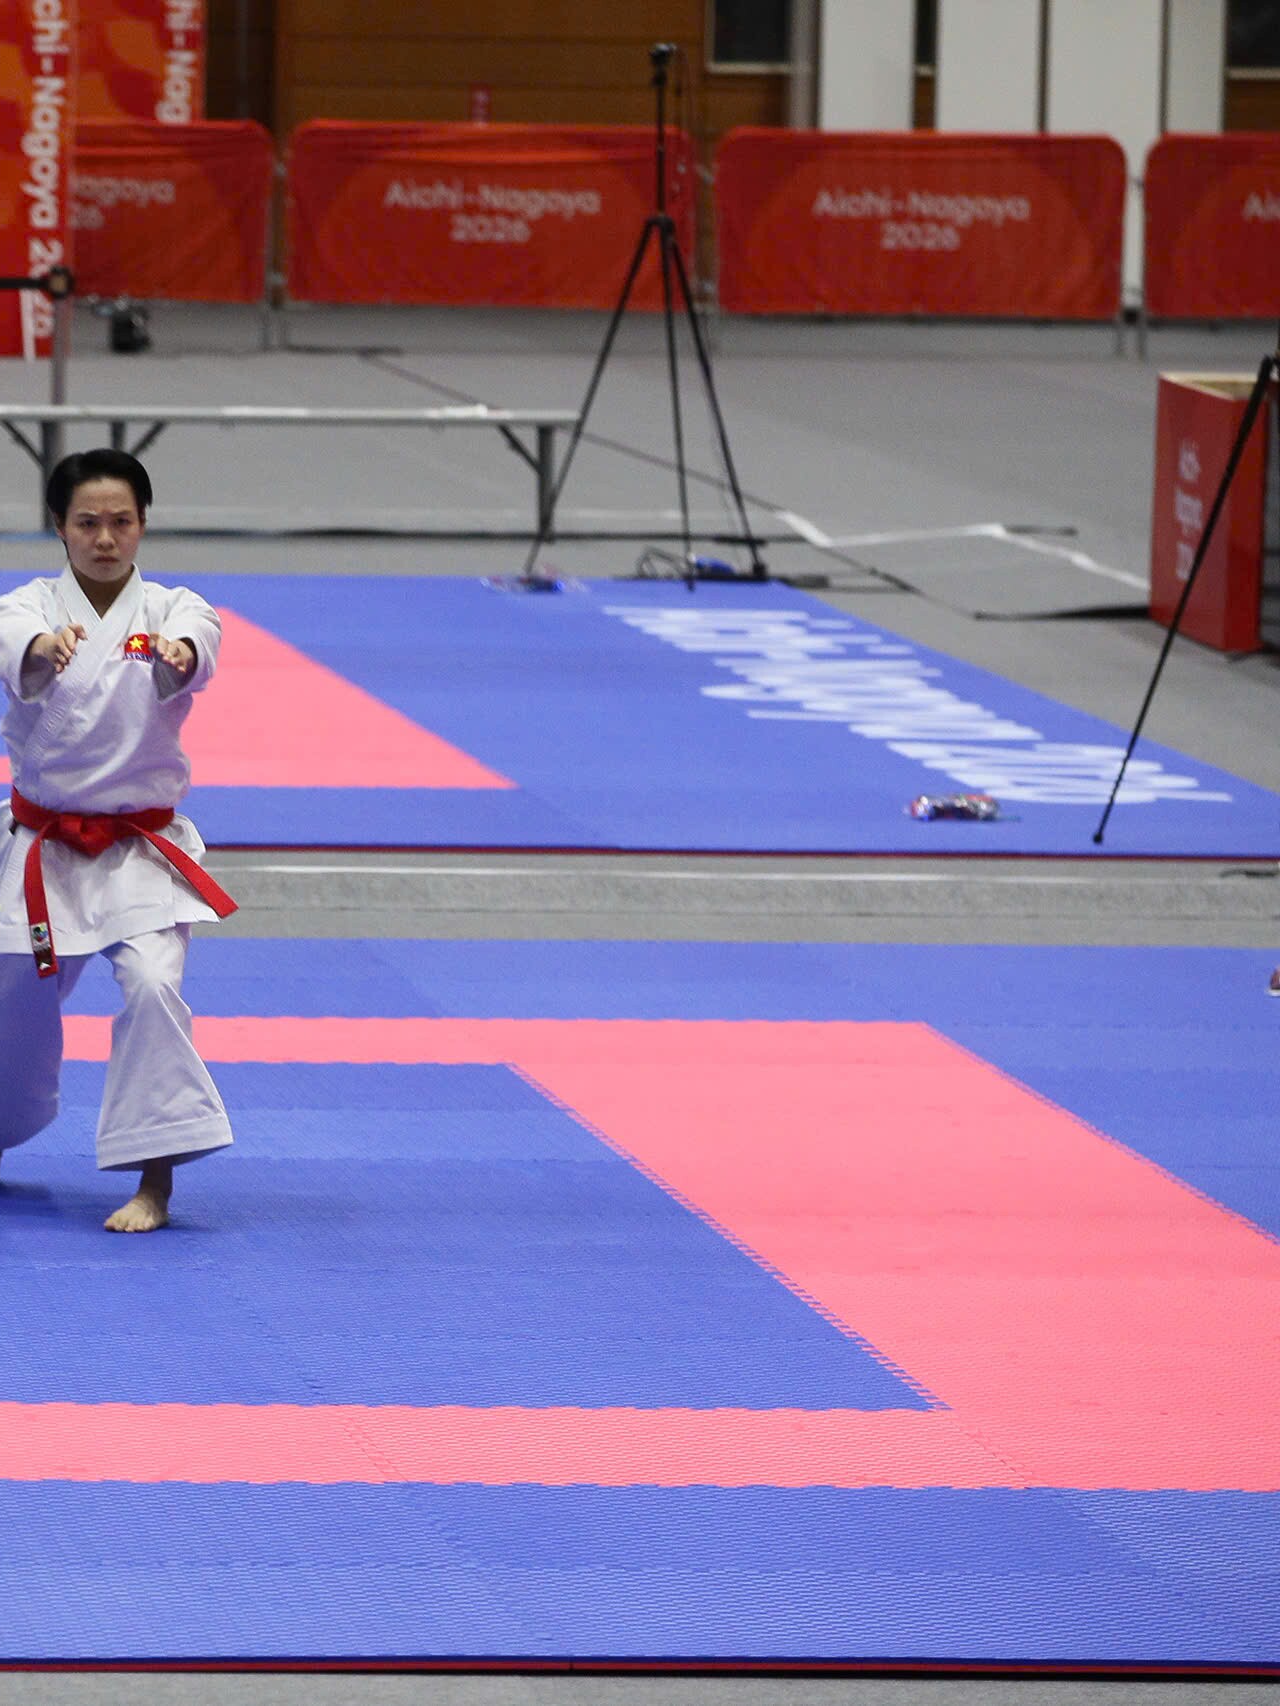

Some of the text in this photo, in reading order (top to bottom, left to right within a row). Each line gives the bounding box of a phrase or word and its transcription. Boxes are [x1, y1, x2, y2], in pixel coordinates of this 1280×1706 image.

[385, 180, 601, 221] Aichi-Nagoya
[813, 188, 1031, 227] Aichi-Nagoya
[451, 214, 531, 243] 2026
[881, 222, 960, 250] 2026
